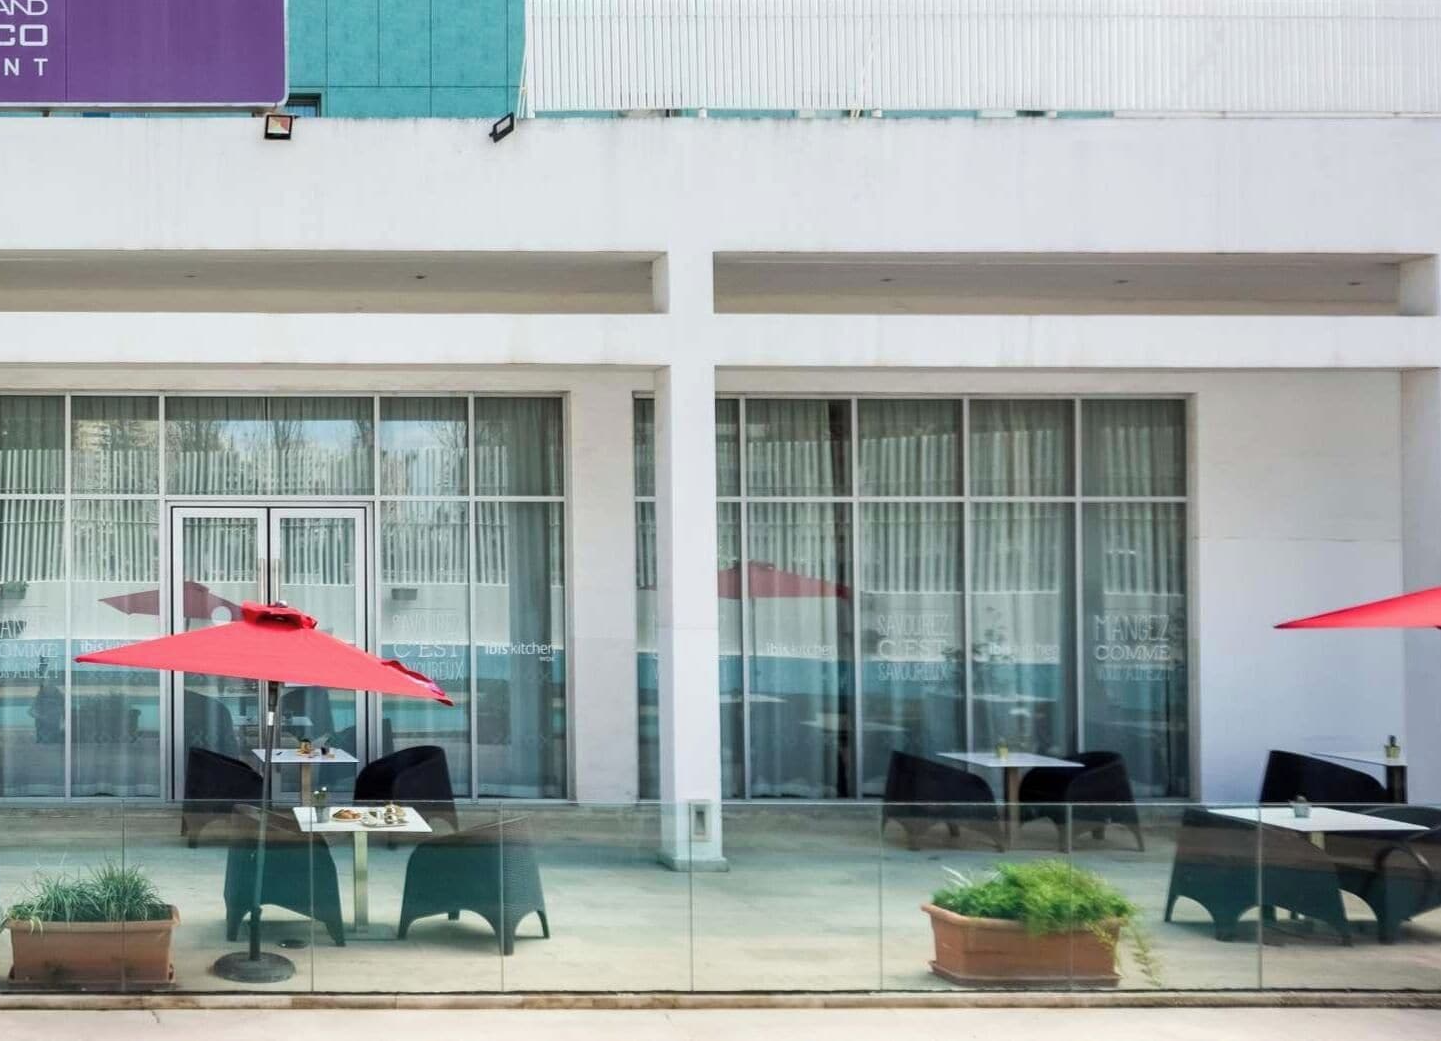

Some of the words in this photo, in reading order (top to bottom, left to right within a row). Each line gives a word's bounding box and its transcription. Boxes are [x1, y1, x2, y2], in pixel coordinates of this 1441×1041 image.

[1094, 614, 1169, 641] MANGEZ
[485, 642, 508, 655] ibis
[510, 642, 556, 655] kitchen
[1095, 645, 1169, 661] COMME
